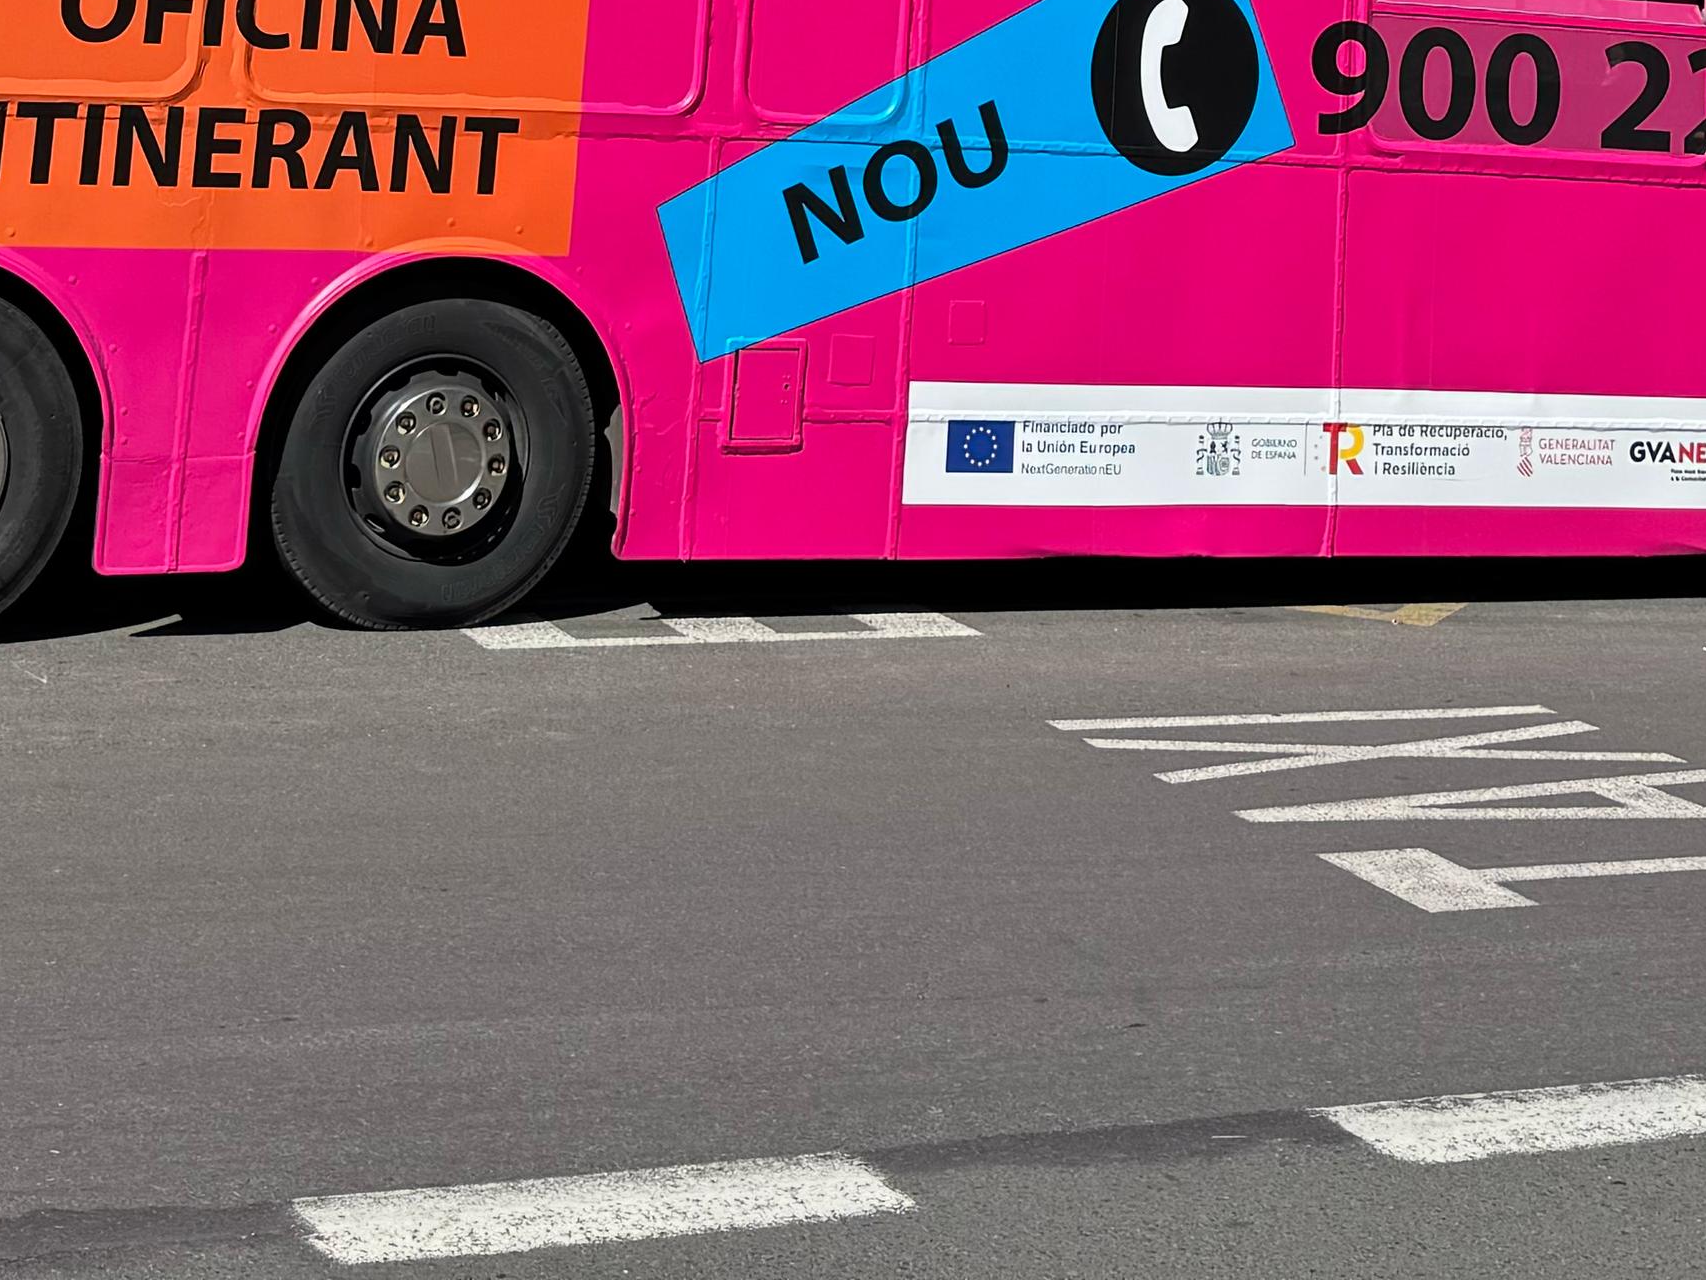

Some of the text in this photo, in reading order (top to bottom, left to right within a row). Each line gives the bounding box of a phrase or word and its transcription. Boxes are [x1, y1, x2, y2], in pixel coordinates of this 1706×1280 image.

[1311, 20, 1562, 146] 900
[782, 100, 1010, 265] NOU
[1022, 420, 1124, 439] Financiado por
[1373, 424, 1394, 437] Pla
[1398, 424, 1415, 437] de
[1021, 439, 1136, 457] la Unión Europea
[1373, 442, 1470, 457] Transformació
[1539, 437, 1616, 452] GENERALITAT
[1539, 452, 1614, 467] VALENCIANA
